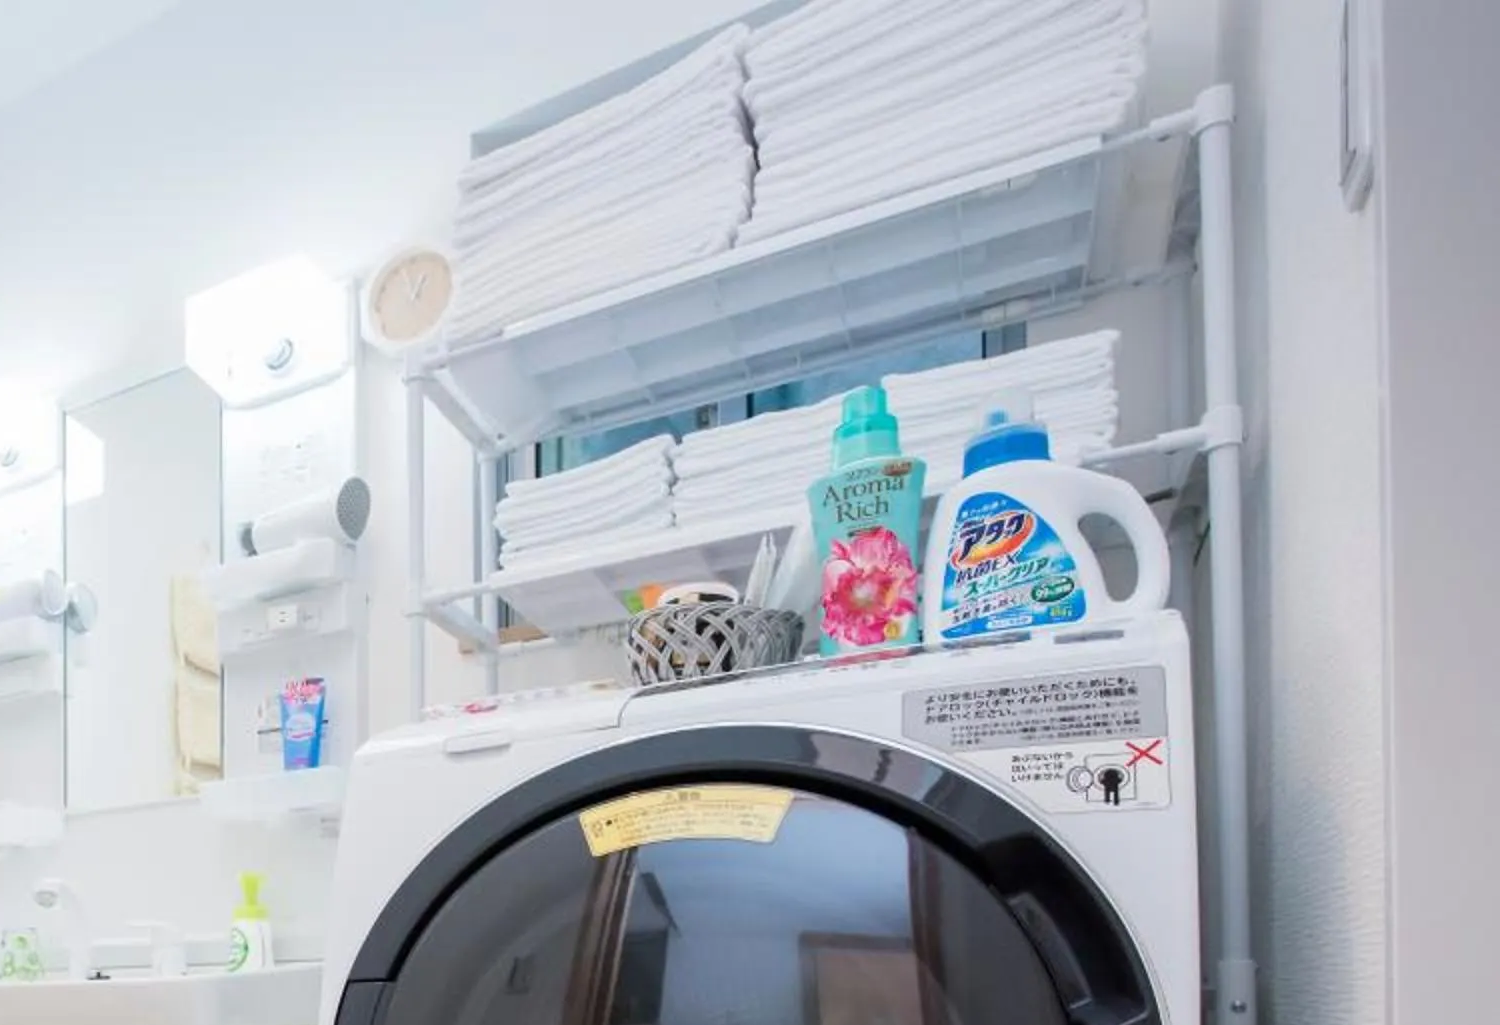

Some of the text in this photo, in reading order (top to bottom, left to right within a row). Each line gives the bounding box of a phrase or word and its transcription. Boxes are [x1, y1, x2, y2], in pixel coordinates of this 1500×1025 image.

[822, 477, 904, 507] Aroma
[835, 495, 889, 523] Rich
[958, 513, 1025, 562] アタック
